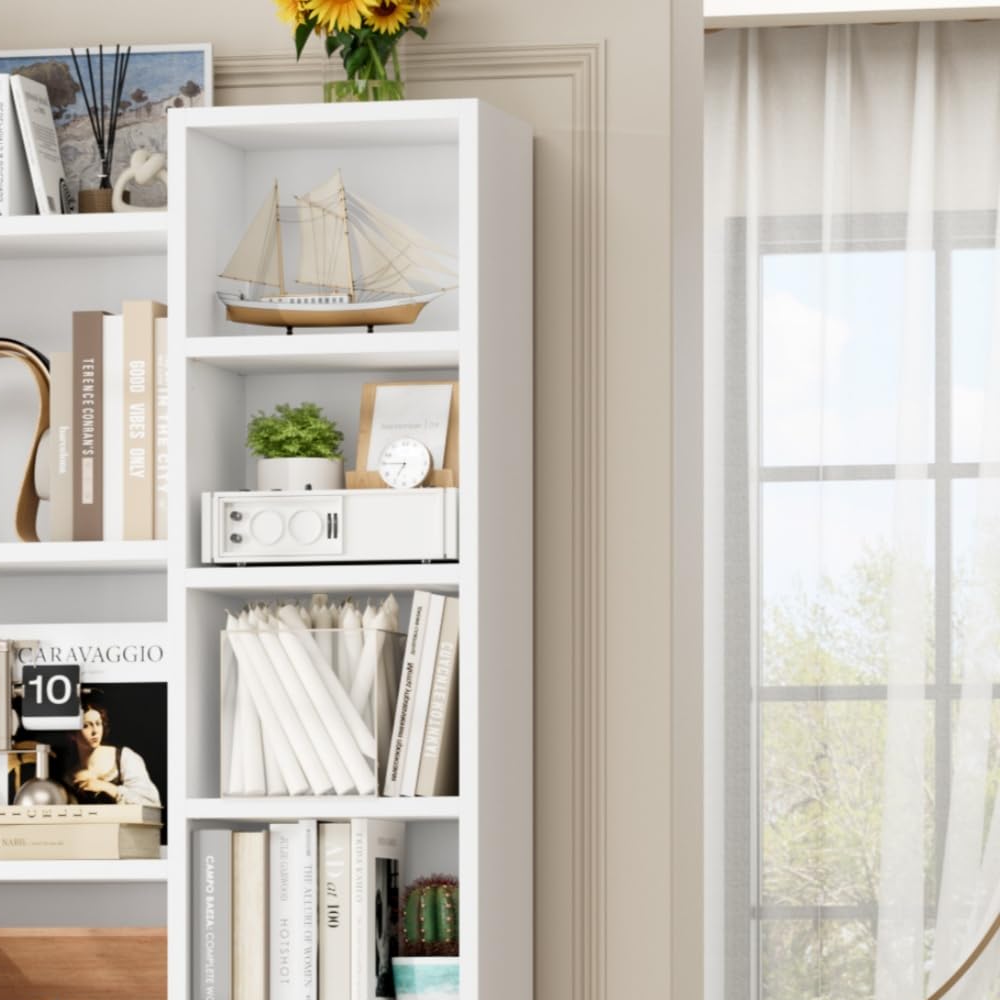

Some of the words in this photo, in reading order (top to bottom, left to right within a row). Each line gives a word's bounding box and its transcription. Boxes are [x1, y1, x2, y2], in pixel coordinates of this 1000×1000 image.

[82, 358, 94, 405] TERENCE
[129, 361, 145, 392] GOOD
[82, 408, 94, 455] CONRAN'S
[129, 403, 145, 438] VIBES
[129, 448, 145, 478] ONLY
[18, 646, 164, 663] CARAVAGGIO
[28, 675, 71, 705] 10
[206, 856, 214, 893] CAMPO
[304, 865, 312, 888] THE
[327, 882, 339, 898] at
[304, 890, 312, 928] ALLURE
[327, 904, 340, 928] 100
[279, 919, 289, 984] HOTSHOT
[304, 931, 312, 944] OF
[206, 932, 214, 983] COMPLETE
[304, 946, 312, 987] WOMEN
